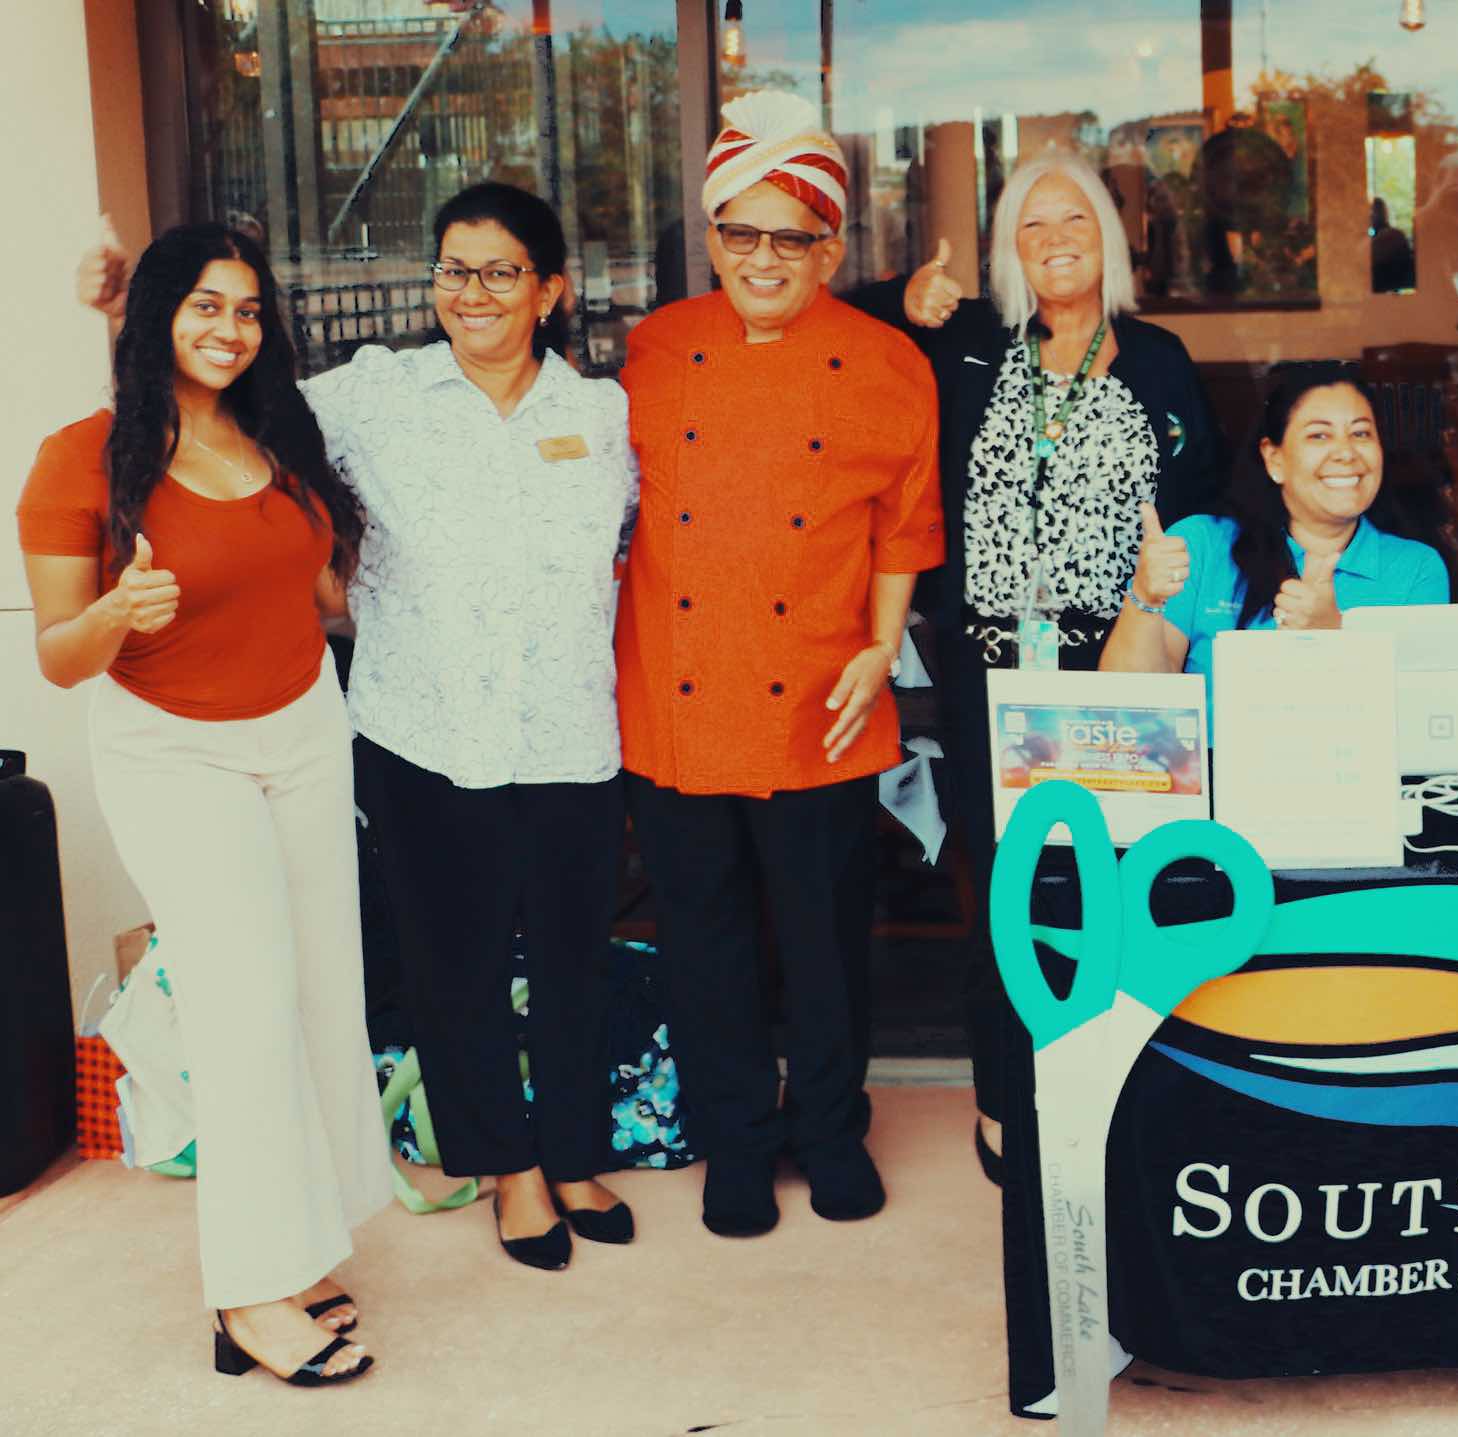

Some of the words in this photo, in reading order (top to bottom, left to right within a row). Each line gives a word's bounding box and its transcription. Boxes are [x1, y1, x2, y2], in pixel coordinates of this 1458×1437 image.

[1047, 1162, 1065, 1246] CHAMBER
[1065, 1199, 1097, 1275] South
[1076, 1280, 1101, 1342] Lake
[1237, 1258, 1452, 1301] CHAMBER
